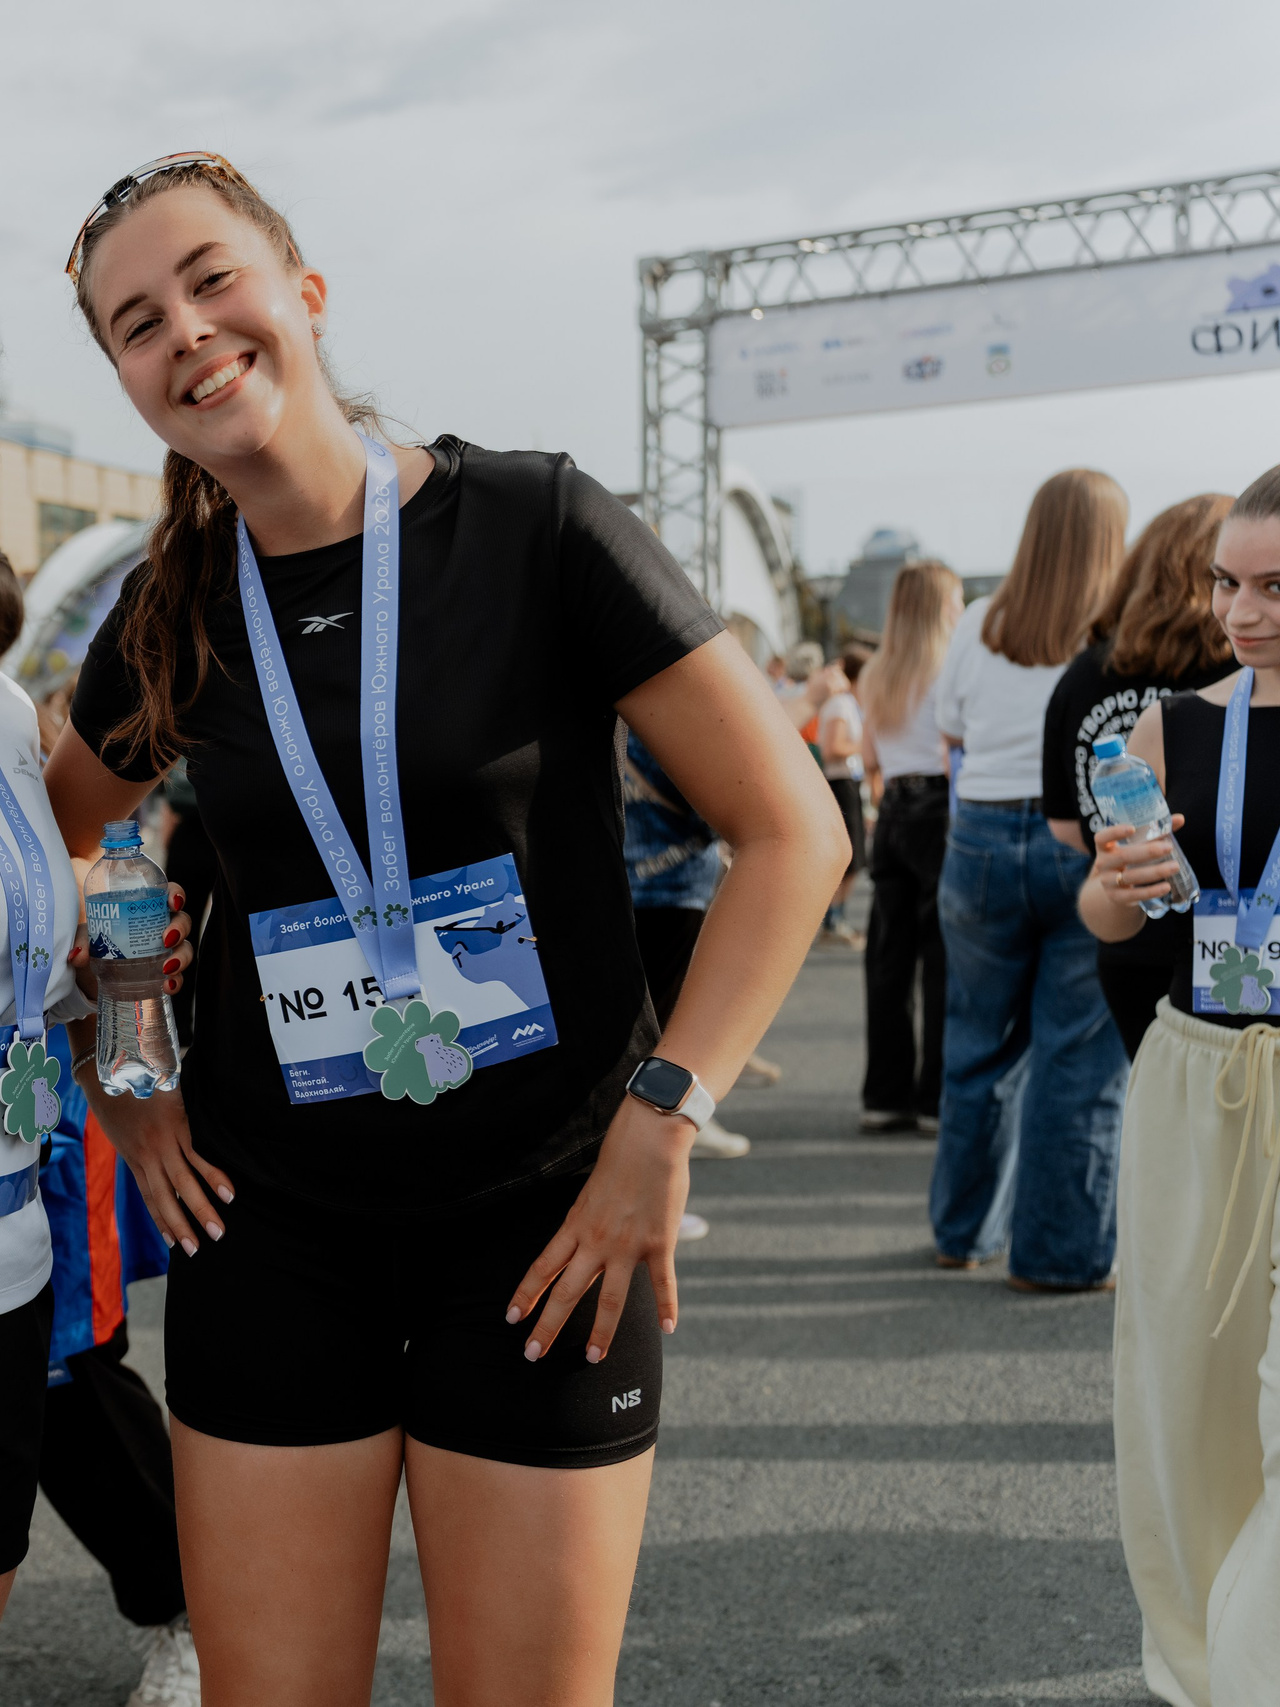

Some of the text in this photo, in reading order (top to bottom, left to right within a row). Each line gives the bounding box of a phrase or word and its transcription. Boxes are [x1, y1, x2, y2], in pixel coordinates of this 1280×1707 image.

[238, 529, 363, 898] Забег волонтёров Южного Урала 2026
[371, 485, 400, 892] Забег волонтёров Южного Урала 2026
[1077, 688, 1138, 744] ТВОРЮ
[9, 880, 25, 932] 2026
[35, 878, 47, 935] Забег
[280, 921, 311, 934] Забег
[454, 877, 495, 894] Урала
[289, 1069, 310, 1077] Беги.
[292, 1076, 329, 1087] Помогай.
[294, 1084, 347, 1098] Вдохновляй.
